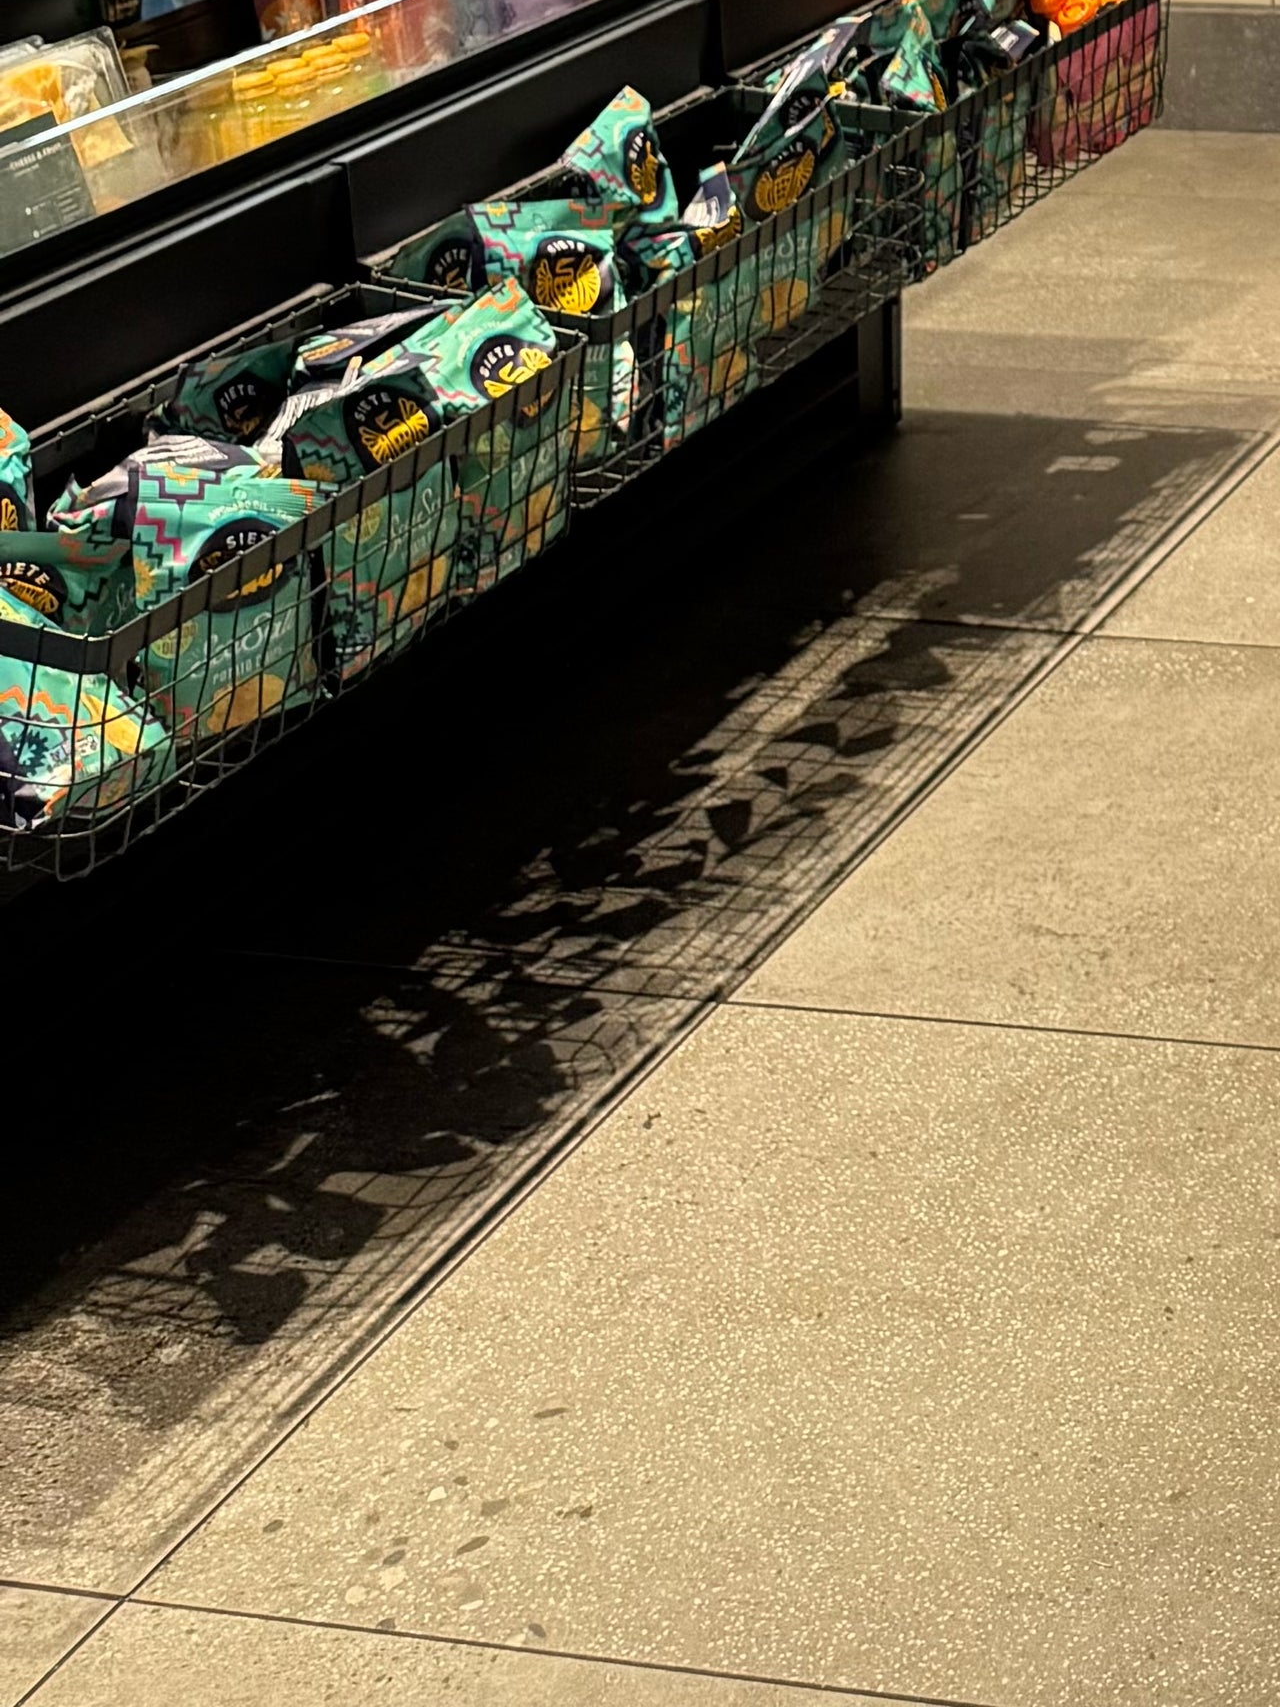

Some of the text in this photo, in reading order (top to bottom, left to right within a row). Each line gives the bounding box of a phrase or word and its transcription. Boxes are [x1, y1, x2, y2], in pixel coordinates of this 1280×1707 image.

[479, 344, 515, 378] SIETE
[219, 383, 257, 412] SIETE
[353, 390, 392, 423] SIETE
[0, 561, 50, 586] IETE
